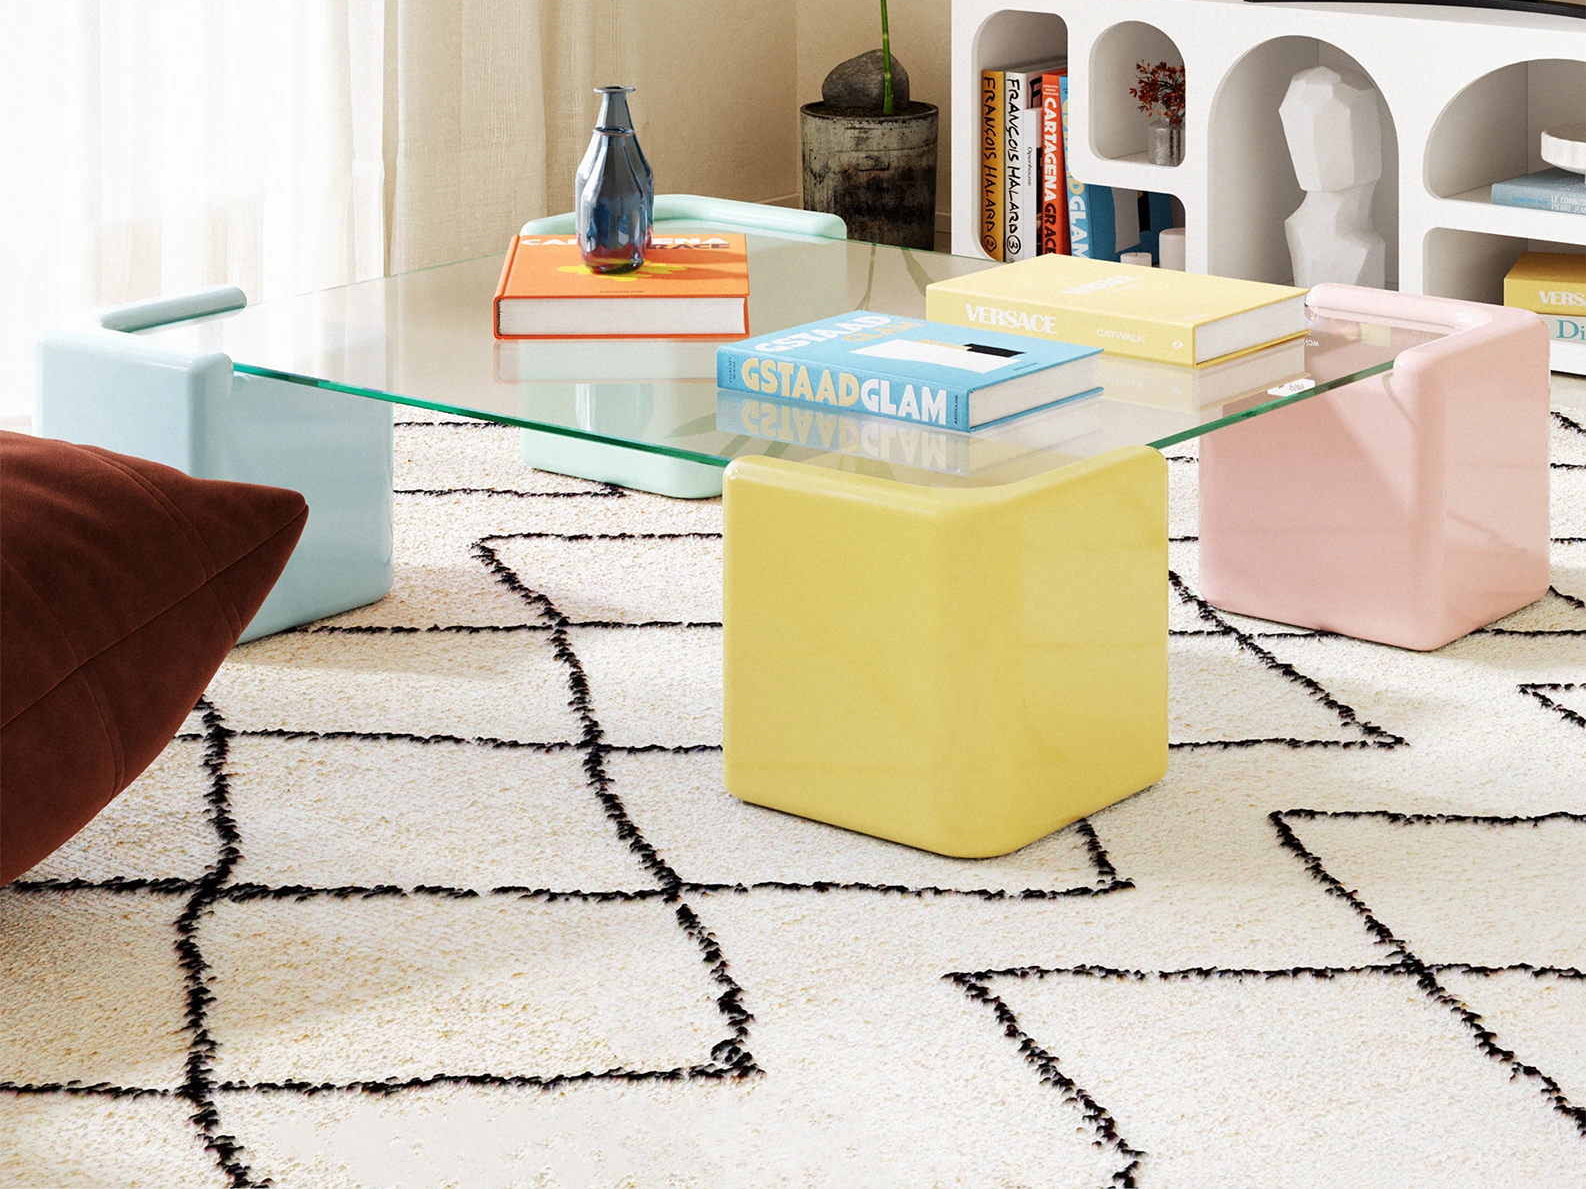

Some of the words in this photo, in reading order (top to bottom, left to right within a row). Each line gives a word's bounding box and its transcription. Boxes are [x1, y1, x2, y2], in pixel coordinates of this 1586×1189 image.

[983, 77, 997, 160] FRANÇOIS
[1005, 79, 1020, 162] FRANÇOIS
[1044, 97, 1057, 202] CARTAGENA
[984, 165, 997, 232] HALARD
[1007, 166, 1021, 234] HALARD
[1551, 203, 1572, 212] PIERRE
[1539, 290, 1586, 306] VERS
[754, 315, 891, 352] GSTAAD
[842, 320, 926, 342] GLAM
[964, 303, 1058, 335] VERSACE
[1096, 329, 1145, 343] CATWALK
